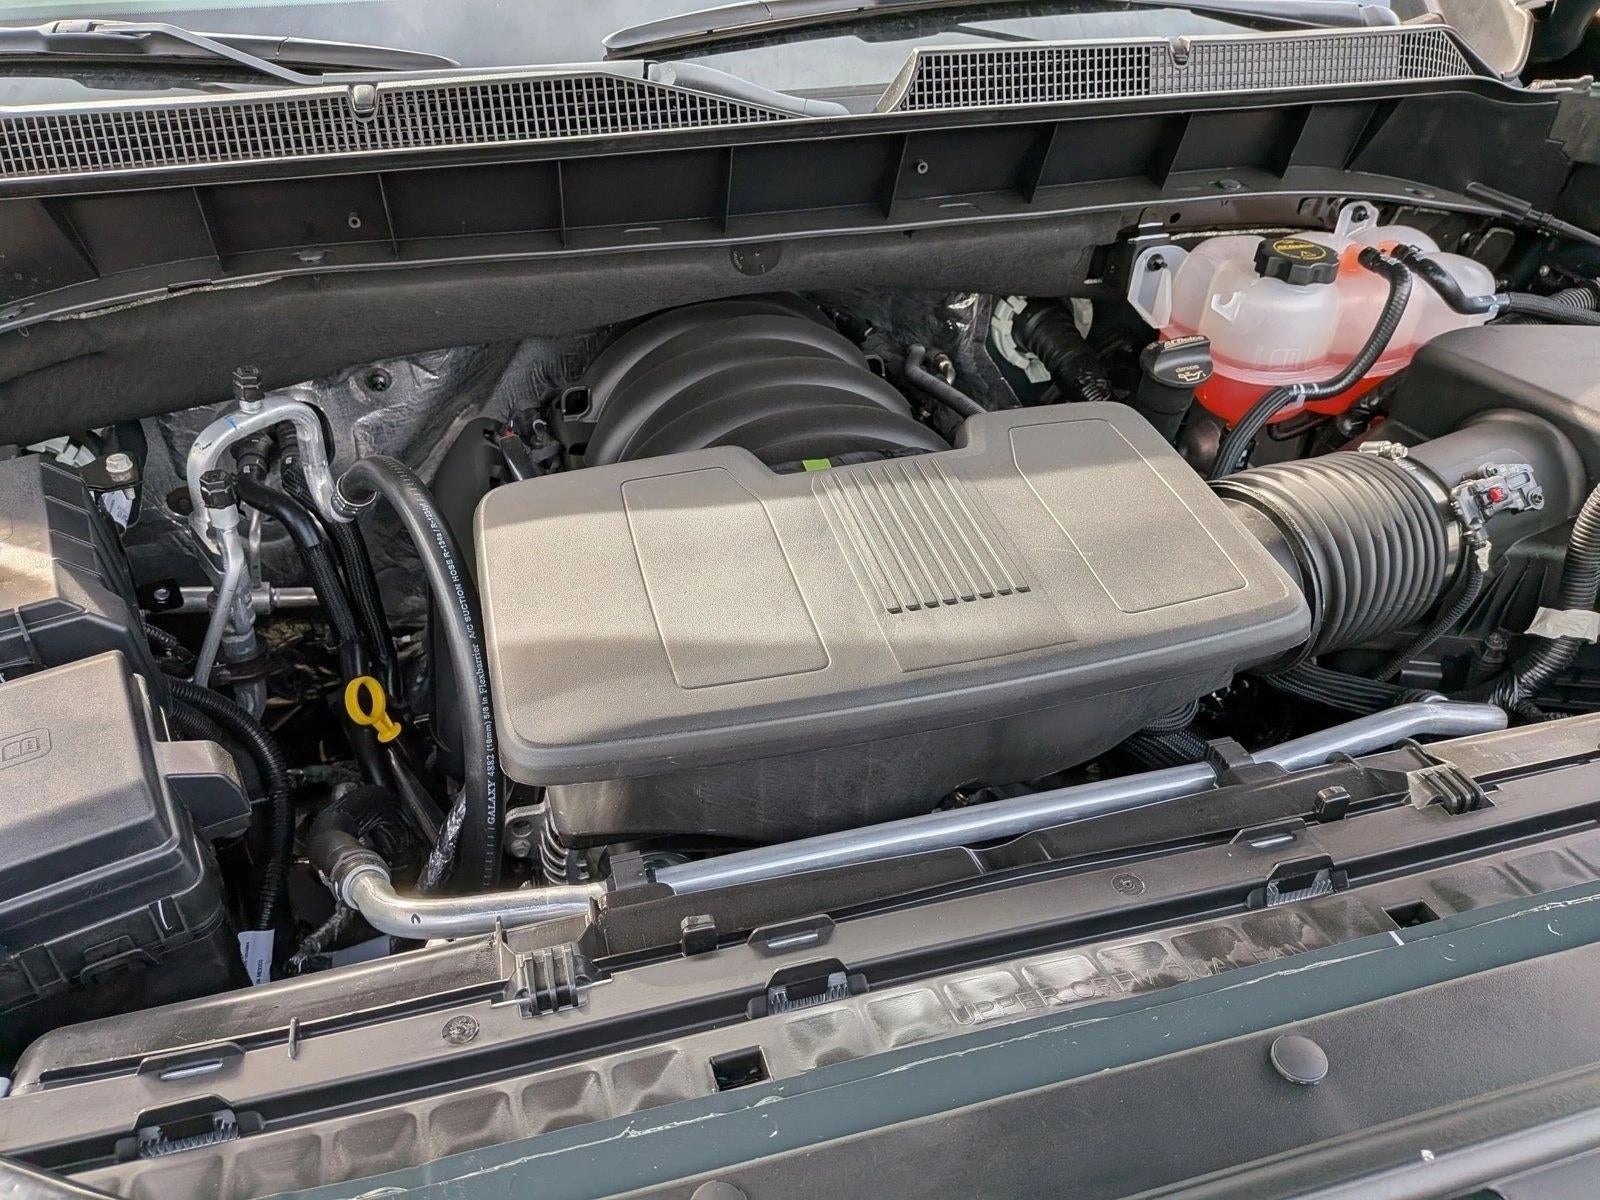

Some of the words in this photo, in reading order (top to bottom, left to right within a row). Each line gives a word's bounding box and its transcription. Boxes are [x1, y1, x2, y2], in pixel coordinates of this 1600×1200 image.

[436, 532, 451, 558] R-134a
[445, 559, 460, 582] HOSE
[455, 583, 472, 622] SUCTION
[466, 623, 477, 639] A/C
[472, 643, 488, 694] Flexbarrier
[482, 706, 490, 720] 5/8
[484, 721, 495, 751] (16mm)
[486, 753, 495, 777] 4882
[487, 780, 497, 825] GALAXY
[949, 988, 1065, 1026] UPPER
